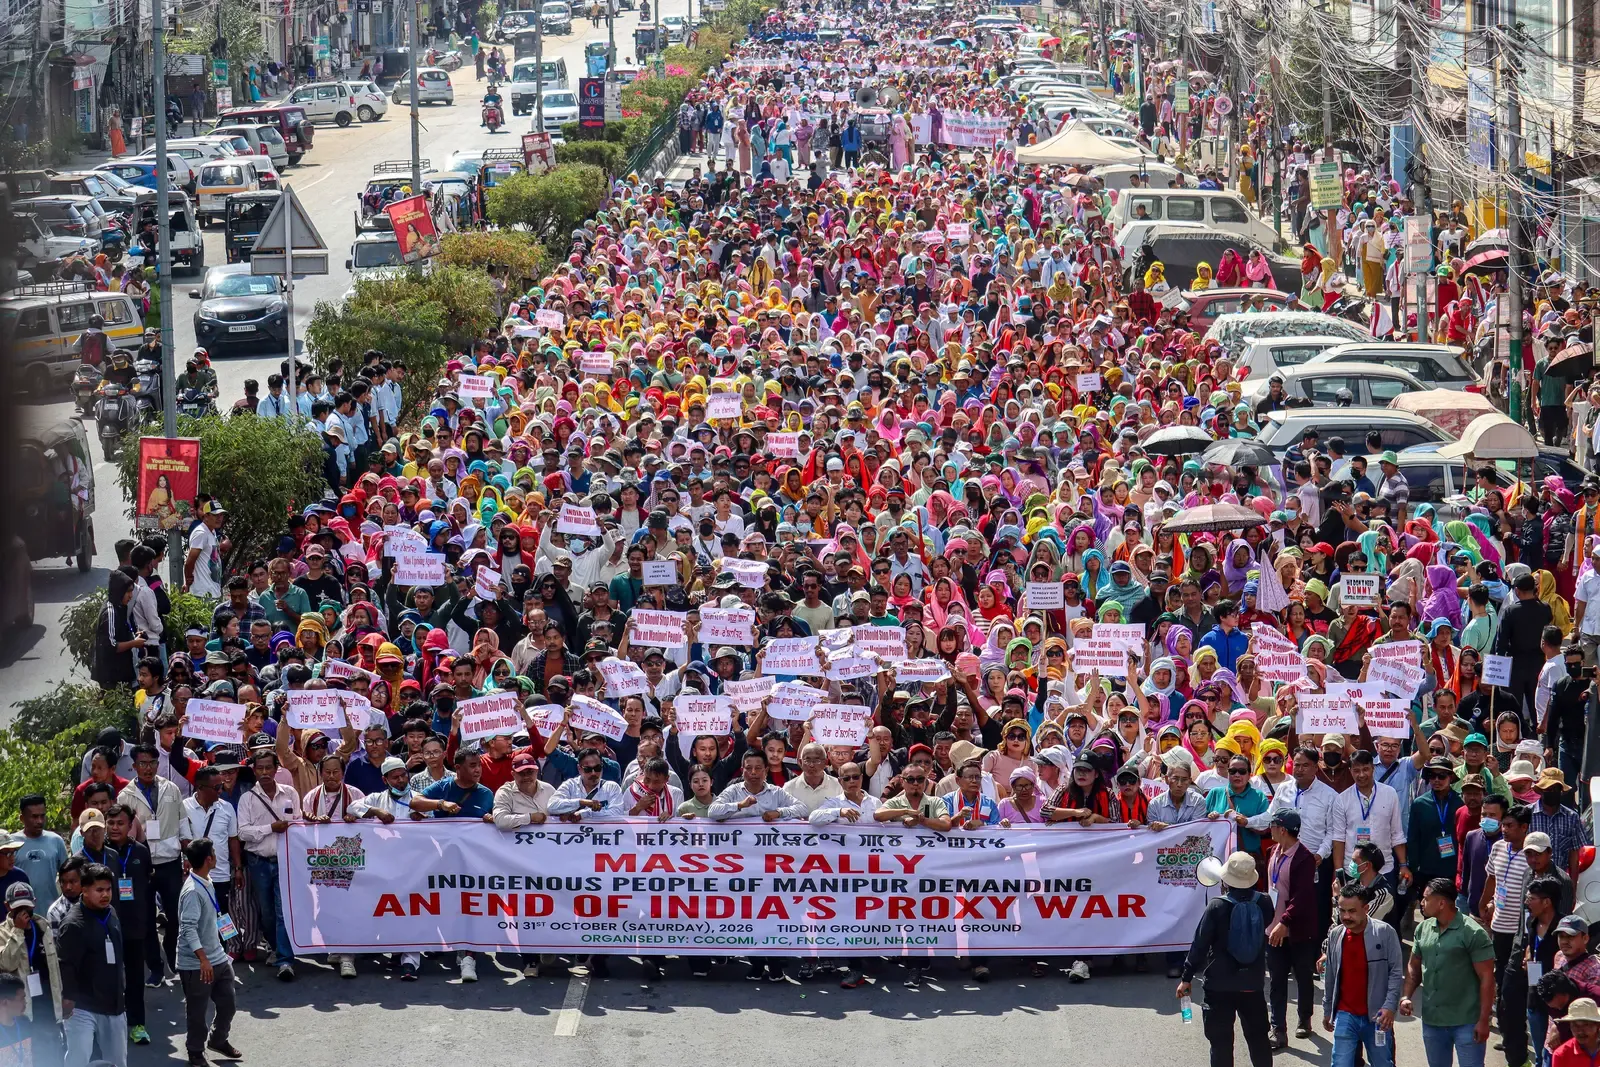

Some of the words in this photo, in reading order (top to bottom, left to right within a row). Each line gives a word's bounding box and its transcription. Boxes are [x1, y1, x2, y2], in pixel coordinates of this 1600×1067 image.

[158, 464, 190, 472] DELIVER
[566, 508, 583, 516] INDIA
[1347, 586, 1371, 595] DUMMY
[644, 614, 659, 625] Should
[659, 614, 669, 626] Stop
[864, 629, 878, 640] Should
[879, 630, 888, 641] Stop
[1257, 656, 1271, 668] Stop
[1272, 654, 1288, 667] Proxy
[472, 701, 488, 715] Should
[488, 699, 499, 712] Stop
[499, 697, 512, 710] Proxy
[501, 714, 517, 728] People
[1144, 784, 1152, 797] We
[306, 855, 366, 866] COCOMI
[594, 852, 745, 873] MASS
[764, 853, 925, 874] RALLY
[1156, 854, 1205, 866] COCO
[428, 874, 602, 892] INDIGENOUS
[612, 876, 722, 892] PEOPLE
[728, 876, 762, 892] OF
[773, 878, 908, 892] MANIPUR
[924, 878, 1092, 893] DEMANDING
[373, 892, 440, 918] AN
[460, 894, 559, 918] END
[573, 894, 632, 918] OF
[651, 895, 837, 920] INDIA'S
[856, 895, 1018, 920] PROXY
[1033, 894, 1147, 918] WAR
[498, 922, 520, 930] ON
[522, 920, 547, 931] 31ST
[550, 922, 618, 932] OCTOBER
[622, 921, 714, 934] (SATURDAY),
[719, 923, 754, 933] 2026
[777, 924, 826, 933] TIDDIM
[830, 924, 892, 933] GROUND
[894, 924, 914, 933] TO
[918, 924, 957, 933] THAU
[960, 924, 1022, 933] GROUND
[580, 934, 665, 944] ORGANISED
[668, 935, 690, 944] BY:
[693, 936, 758, 946] COCOMI,
[761, 936, 794, 946] JTC,
[796, 936, 840, 946] FNCC,
[843, 936, 880, 946] NPUI,
[884, 936, 938, 946] NHACM
